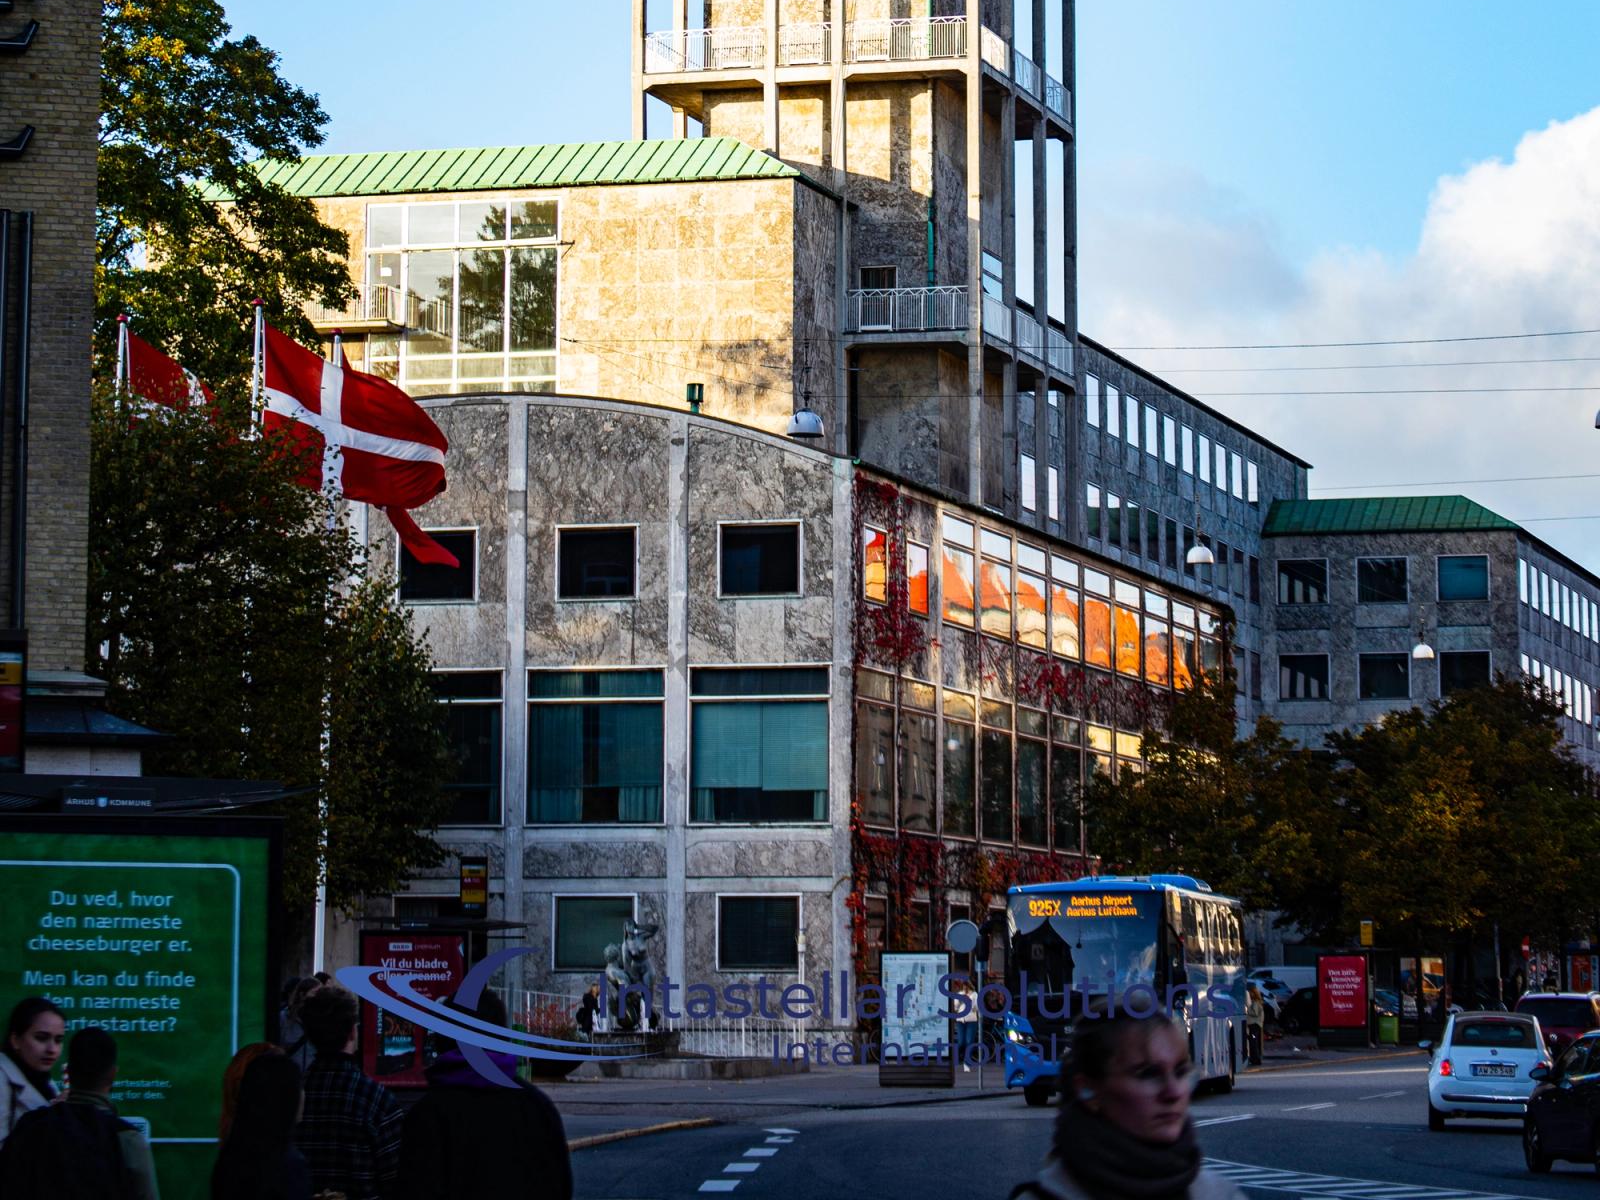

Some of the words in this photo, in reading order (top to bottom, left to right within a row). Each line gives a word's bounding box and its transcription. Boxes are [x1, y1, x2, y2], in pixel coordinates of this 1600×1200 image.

[109, 798, 153, 807] KOMMUNE
[50, 890, 77, 907] Du
[83, 890, 123, 908] ved,
[130, 890, 174, 907] hvor
[1071, 896, 1101, 906] Aarhus
[1103, 895, 1133, 906] Airport
[1029, 900, 1061, 916] 925X
[1067, 907, 1097, 917] Aarhus
[1098, 906, 1138, 916] Lufthavn
[40, 912, 77, 929] den
[83, 914, 183, 930] nærmeste
[27, 934, 163, 956] cheeseburger
[168, 938, 192, 952] er.
[380, 958, 396, 969] Vil
[398, 958, 412, 969] du
[415, 958, 448, 969] bladre
[23, 970, 67, 986] Men
[72, 969, 108, 986] kan
[115, 970, 139, 987] du
[145, 970, 196, 988] finde
[81, 994, 180, 1010] nærmeste
[64, 1016, 177, 1032] ertestarter?
